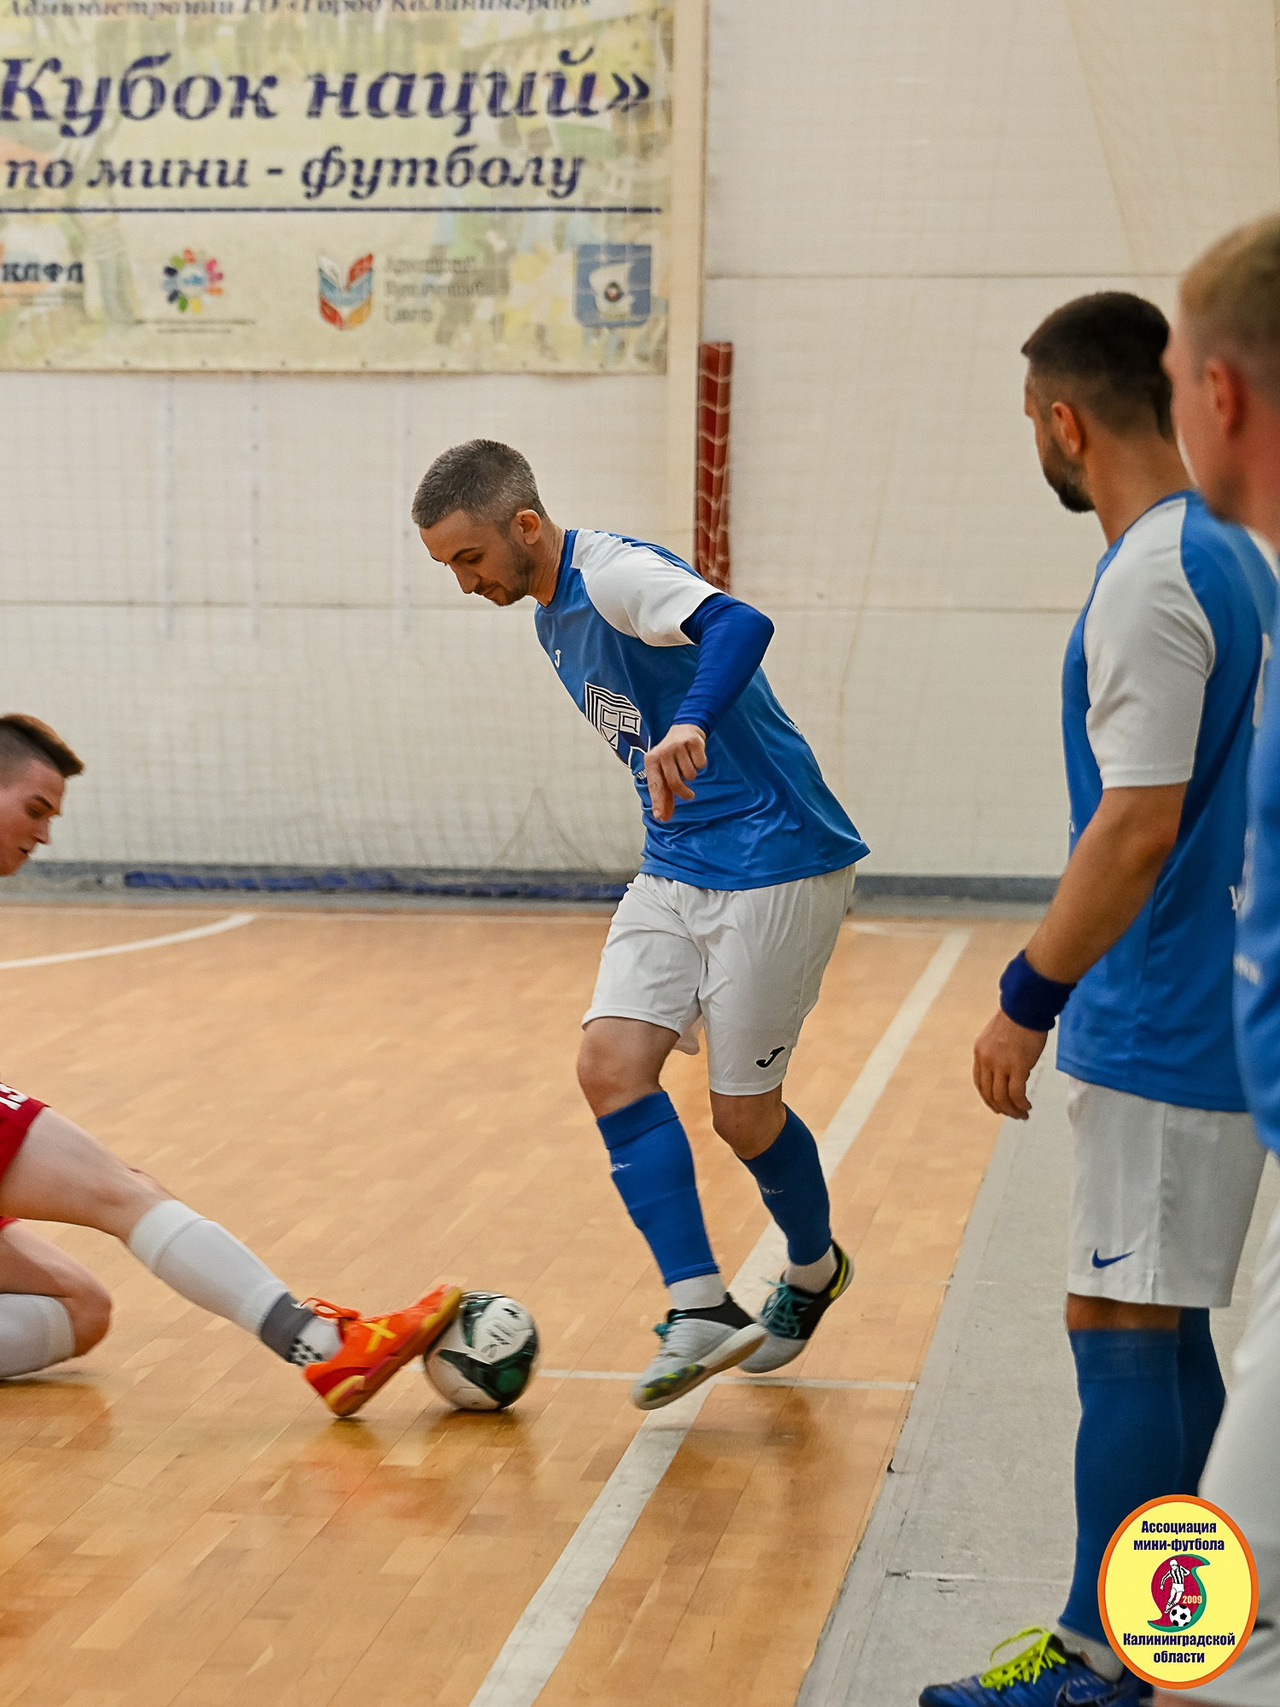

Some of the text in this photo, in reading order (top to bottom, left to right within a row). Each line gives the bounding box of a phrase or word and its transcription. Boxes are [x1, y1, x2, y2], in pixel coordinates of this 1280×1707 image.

[305, 47, 651, 138] наций»
[6, 159, 74, 190] по
[87, 159, 250, 190] мини
[301, 145, 585, 199] футболу
